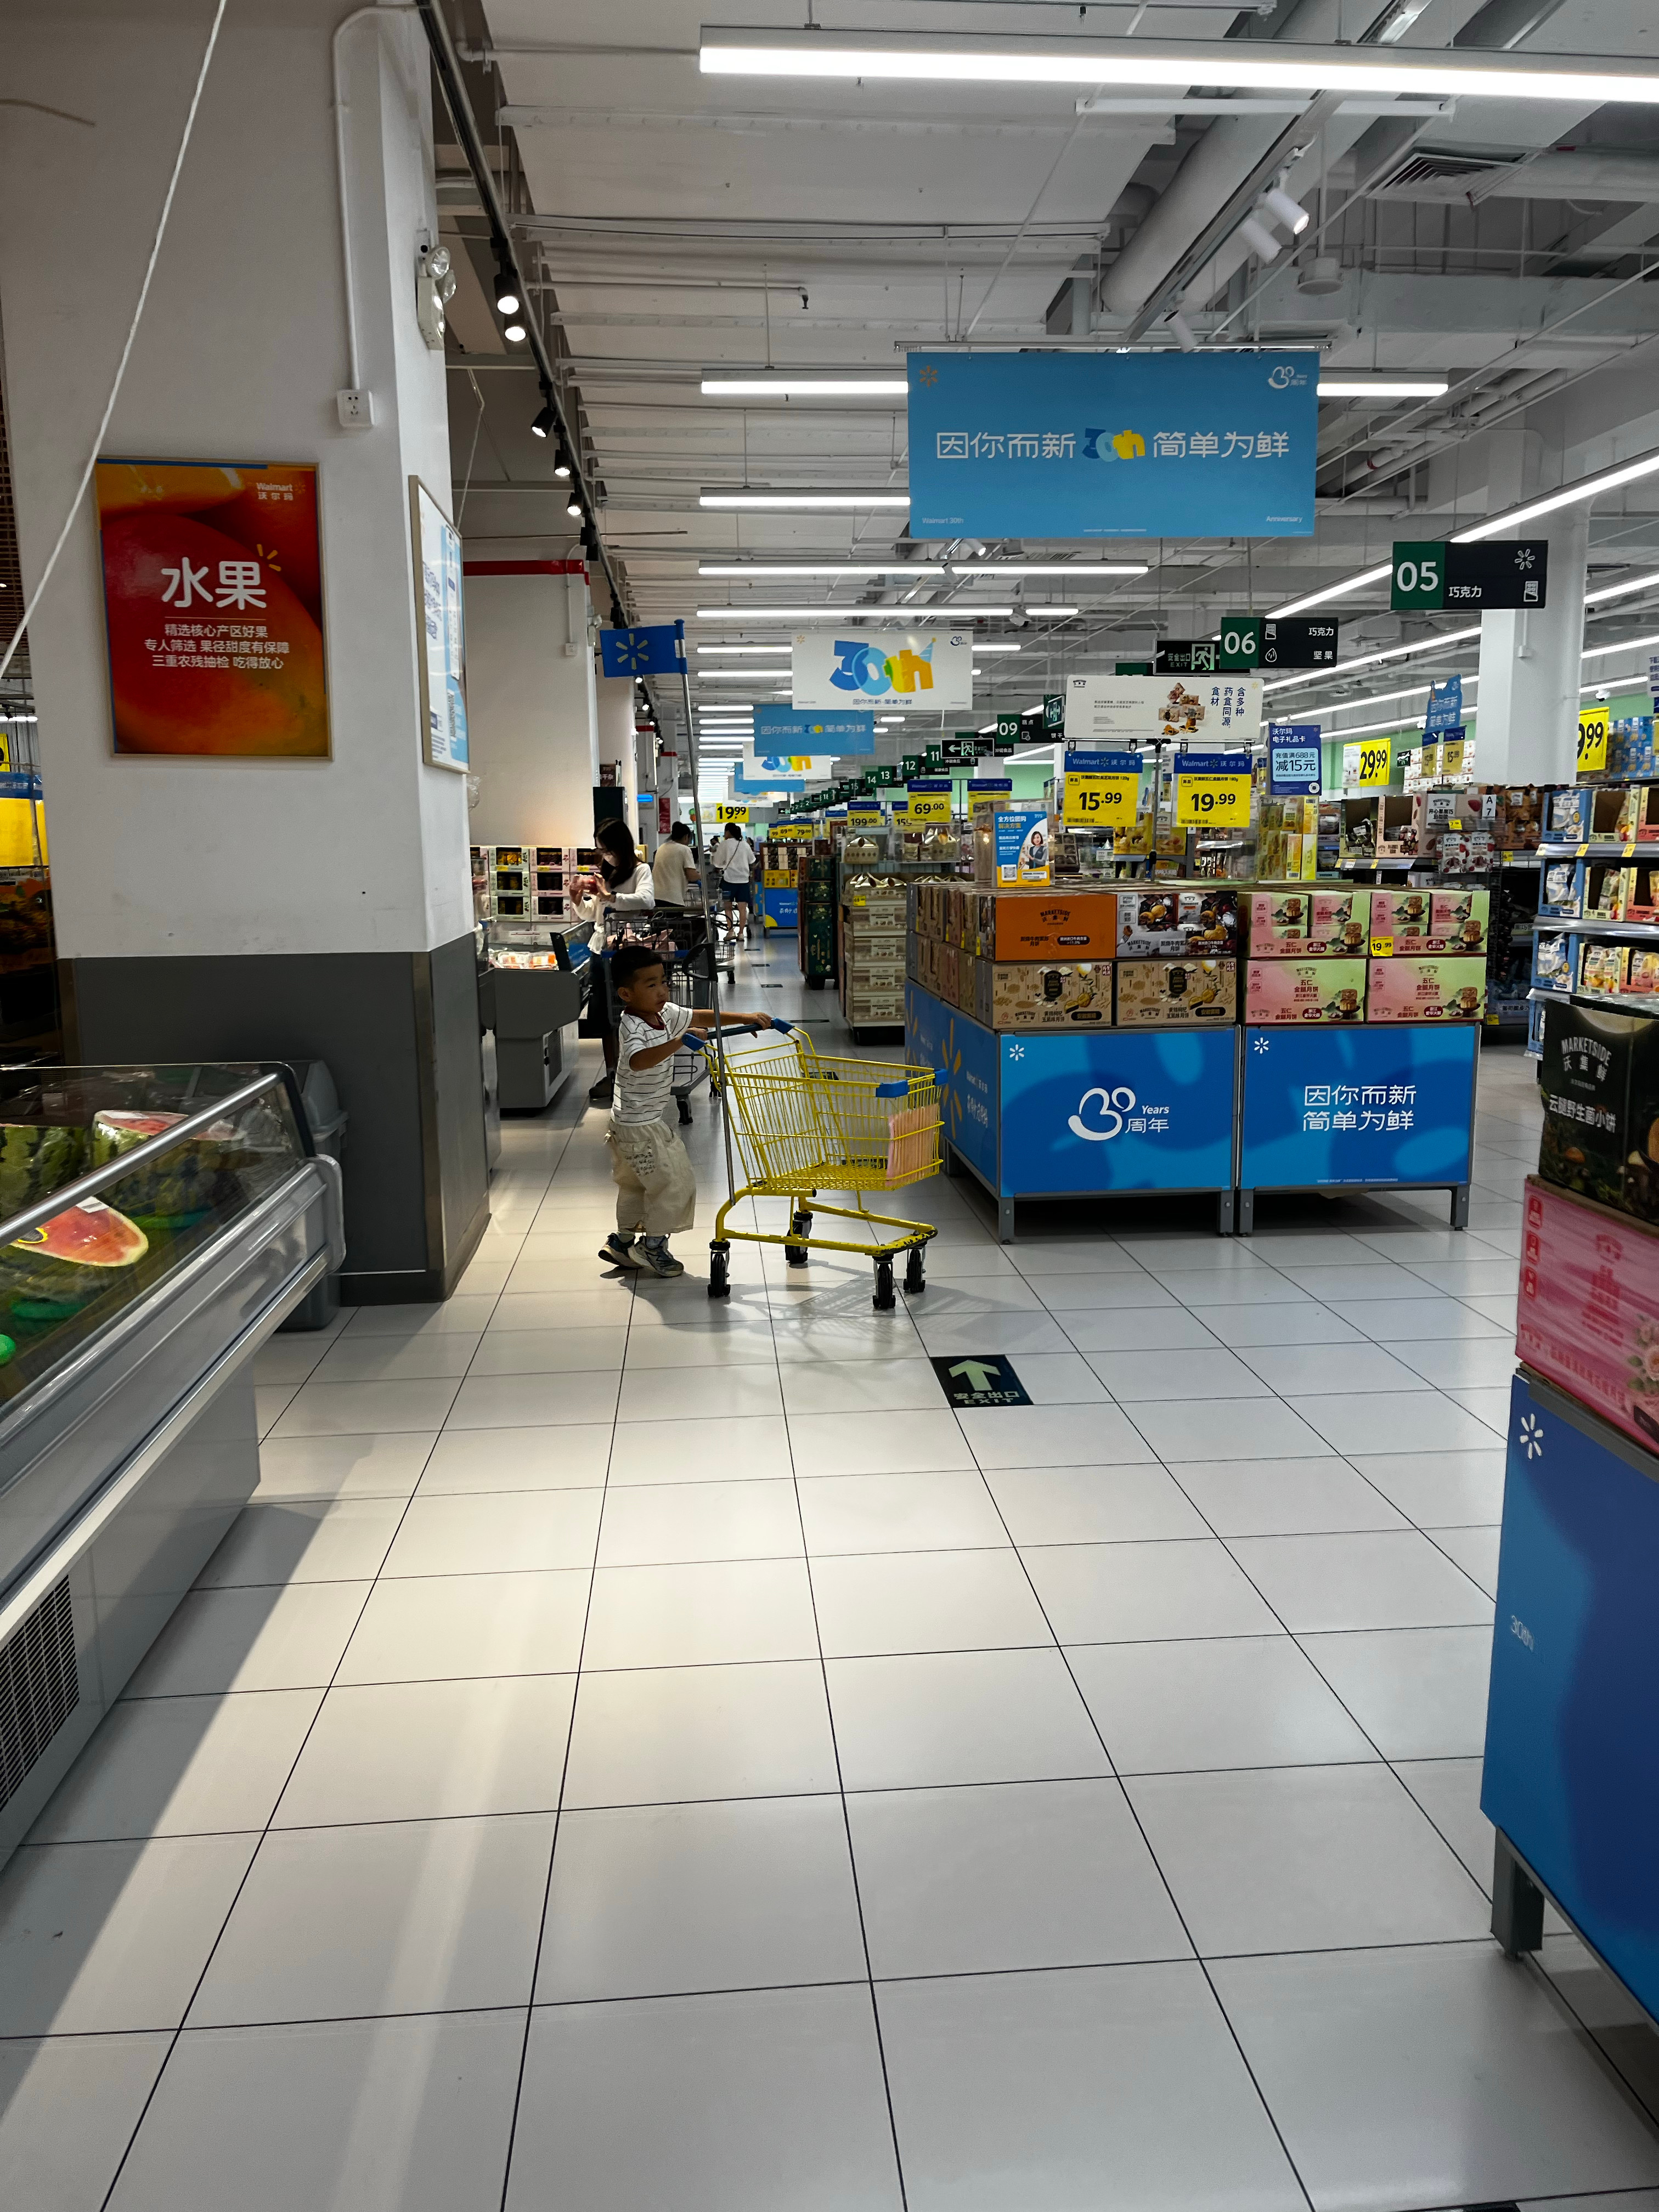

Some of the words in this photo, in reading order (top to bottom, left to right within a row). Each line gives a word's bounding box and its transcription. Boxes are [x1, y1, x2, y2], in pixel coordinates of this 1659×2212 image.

[936, 431, 1076, 459] 因你而新
[1153, 431, 1290, 459] 简单为鲜
[256, 483, 293, 492] Walmart
[1266, 515, 1303, 524] Anniversary
[1396, 561, 1440, 592] 05
[161, 557, 267, 611] 水果
[1448, 585, 1482, 599] 巧克力
[165, 623, 268, 638] 精选核心产区好果
[1308, 626, 1335, 637] 巧克力
[144, 639, 196, 652] 专人筛选
[200, 640, 290, 654] 果径甜度有保障
[1223, 631, 1256, 656] 06
[152, 654, 230, 668] 三重农残抽检
[233, 656, 284, 669] 吃得放心
[1167, 652, 1191, 662] 安全出口
[1313, 650, 1333, 661] 坚果
[829, 640, 934, 696] 30th
[1210, 686, 1221, 706] 食材
[1235, 686, 1246, 717] 含多种
[1221, 686, 1233, 726] 药食同源
[761, 725, 803, 735] 因你而新
[825, 724, 866, 733] 简单为鲜
[998, 722, 1018, 736] 09
[930, 751, 939, 761] 11
[905, 760, 916, 770] 12
[1276, 759, 1316, 771] 减15元
[1359, 749, 1387, 780] 29.99
[867, 776, 877, 784] 14
[881, 770, 890, 780] 13
[1079, 792, 1122, 810] 15.99
[1191, 793, 1236, 812] 19.99
[1486, 795, 1493, 804] A
[716, 806, 747, 820] 19.99
[915, 803, 945, 815] 69.00
[1486, 808, 1492, 816] 7
[850, 818, 877, 826] 199.00
[1040, 909, 1071, 917] MARKETSIDE
[1372, 942, 1392, 951] 19.99
[1561, 1036, 1612, 1067] MARKETSIDE
[1304, 1085, 1417, 1107] 因你而新
[1141, 1104, 1170, 1115] Years
[1549, 1094, 1617, 1133] 云腿野生菌小饼
[1125, 1118, 1170, 1135] 周年
[1302, 1110, 1414, 1132] 简单为鲜
[953, 1391, 1020, 1400] 安全出口
